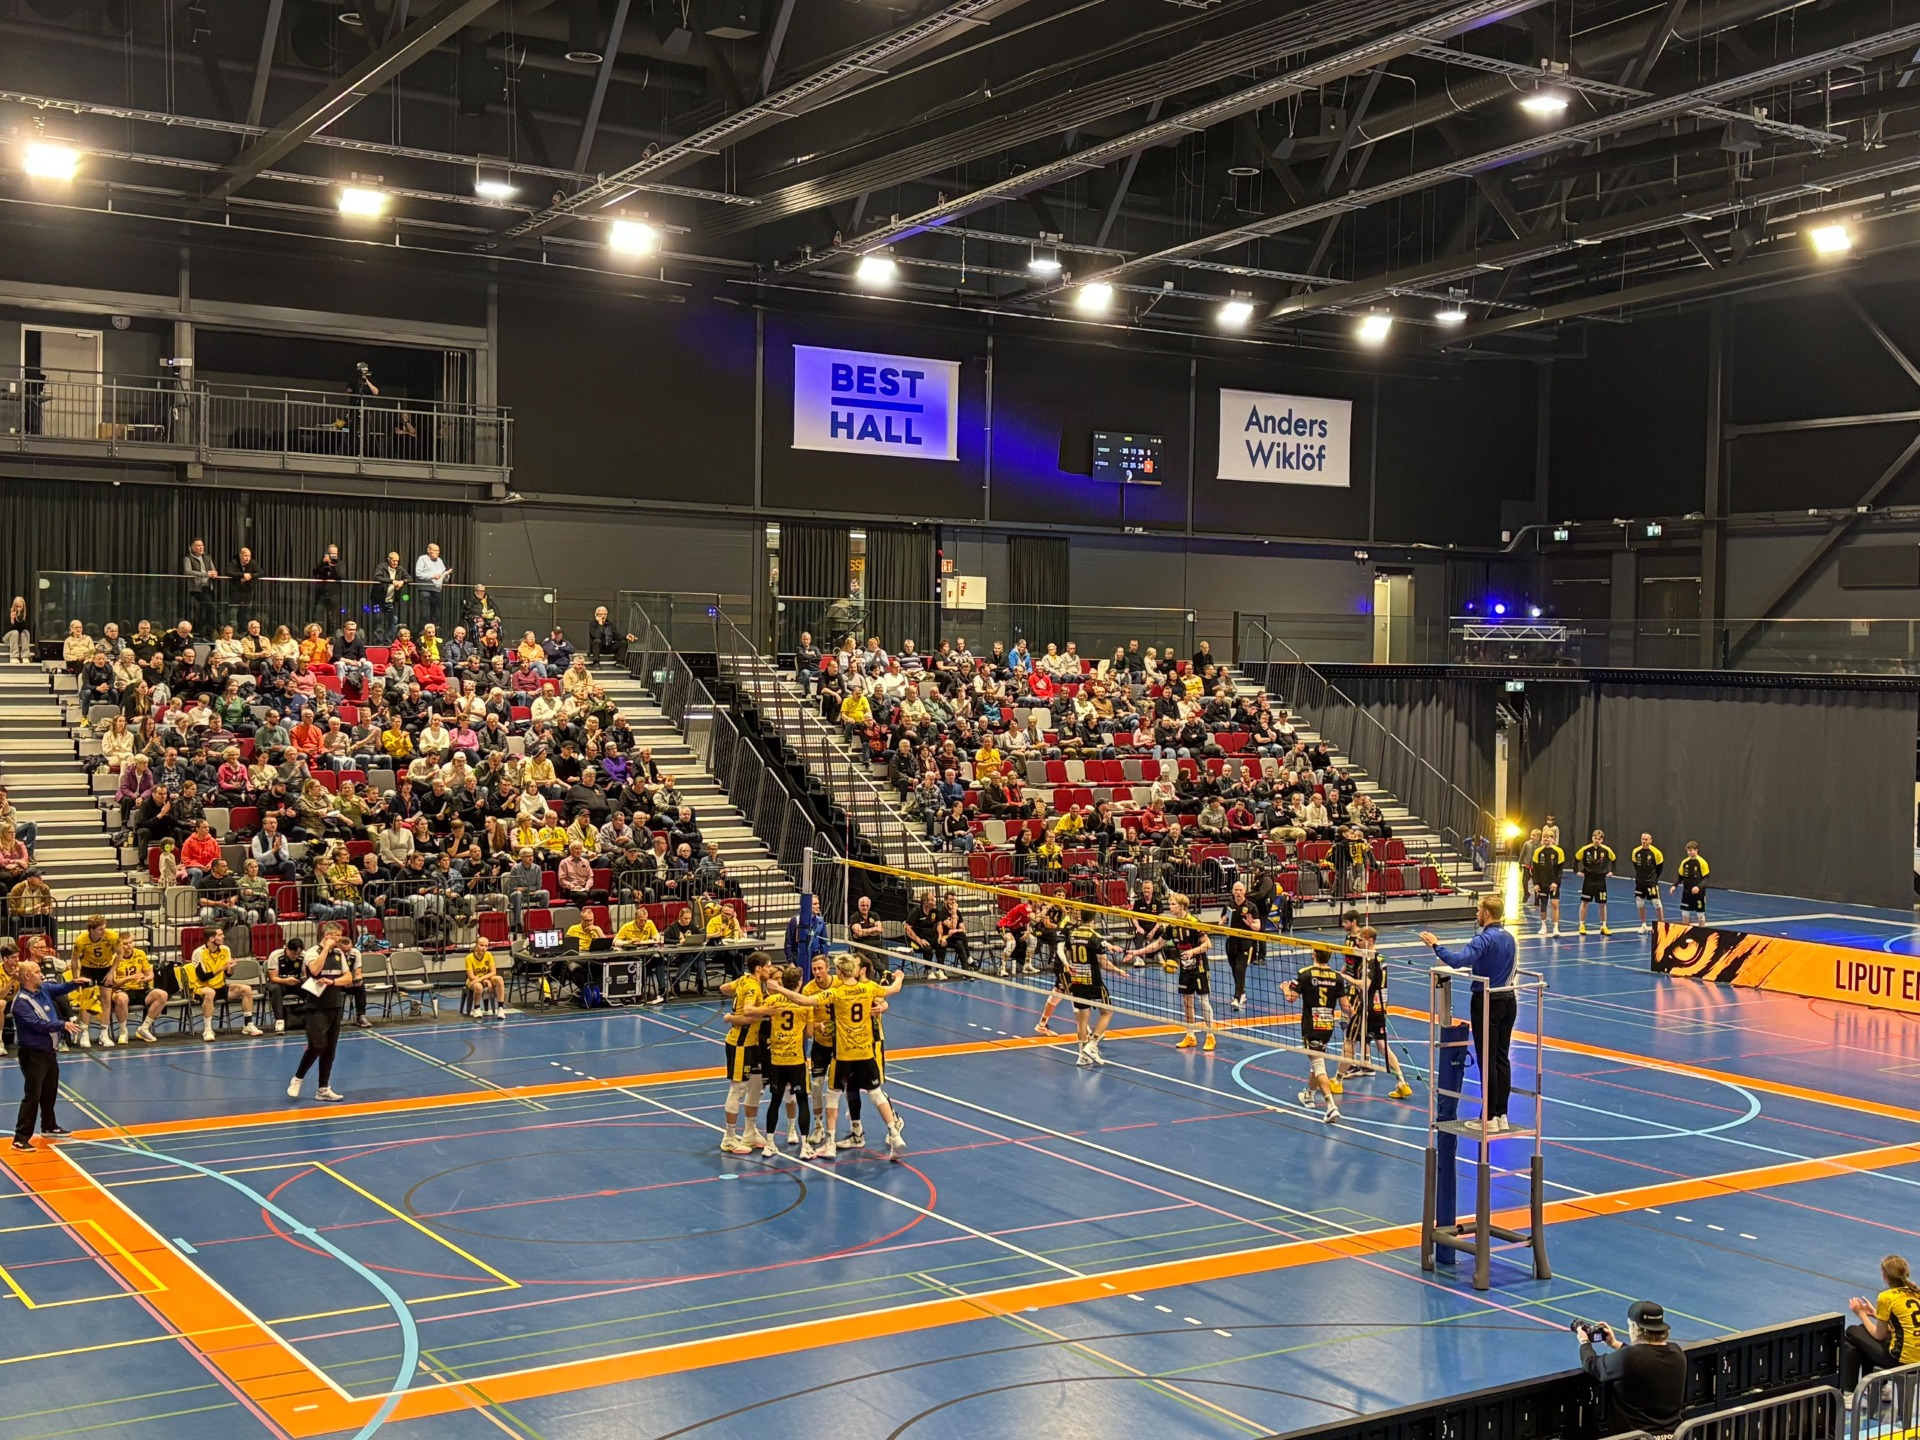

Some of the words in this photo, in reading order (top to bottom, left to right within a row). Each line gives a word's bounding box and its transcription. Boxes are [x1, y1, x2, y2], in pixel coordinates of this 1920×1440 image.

[832, 363, 924, 398] BEST
[831, 411, 922, 445] HALL
[1244, 404, 1328, 438] Anders
[1245, 440, 1326, 471] Wiklöf
[1599, 892, 1607, 901] 12
[1697, 900, 1702, 909] 3
[538, 936, 544, 945] 5
[550, 935, 556, 944] 9
[1070, 944, 1088, 964] 10
[1835, 960, 1896, 997] LIPUT
[1318, 986, 1328, 1007] 5
[780, 1010, 795, 1031] 3
[850, 1002, 863, 1023] 8
